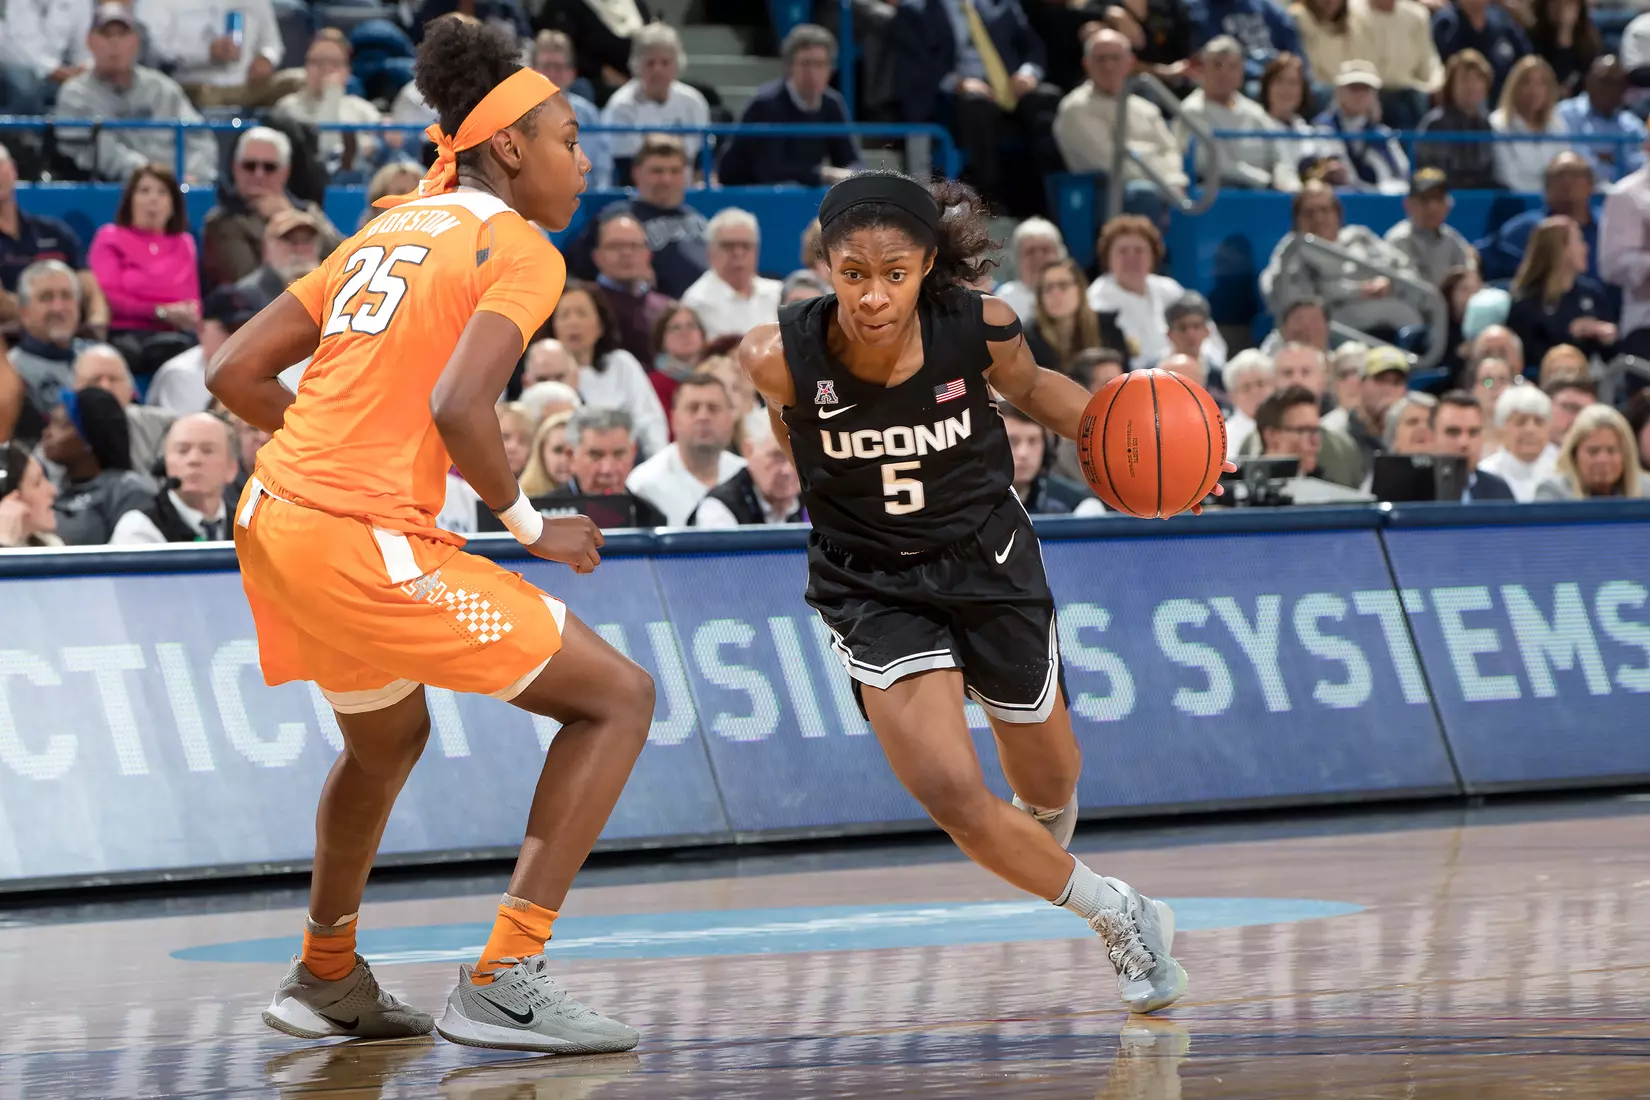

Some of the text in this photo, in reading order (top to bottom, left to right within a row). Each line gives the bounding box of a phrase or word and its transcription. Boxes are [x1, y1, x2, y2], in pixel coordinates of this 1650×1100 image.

[322, 244, 431, 339] 25
[820, 408, 972, 460] UCONN
[881, 460, 926, 516] 5
[0, 580, 1650, 781] CTIC USIS SYSTEMS
